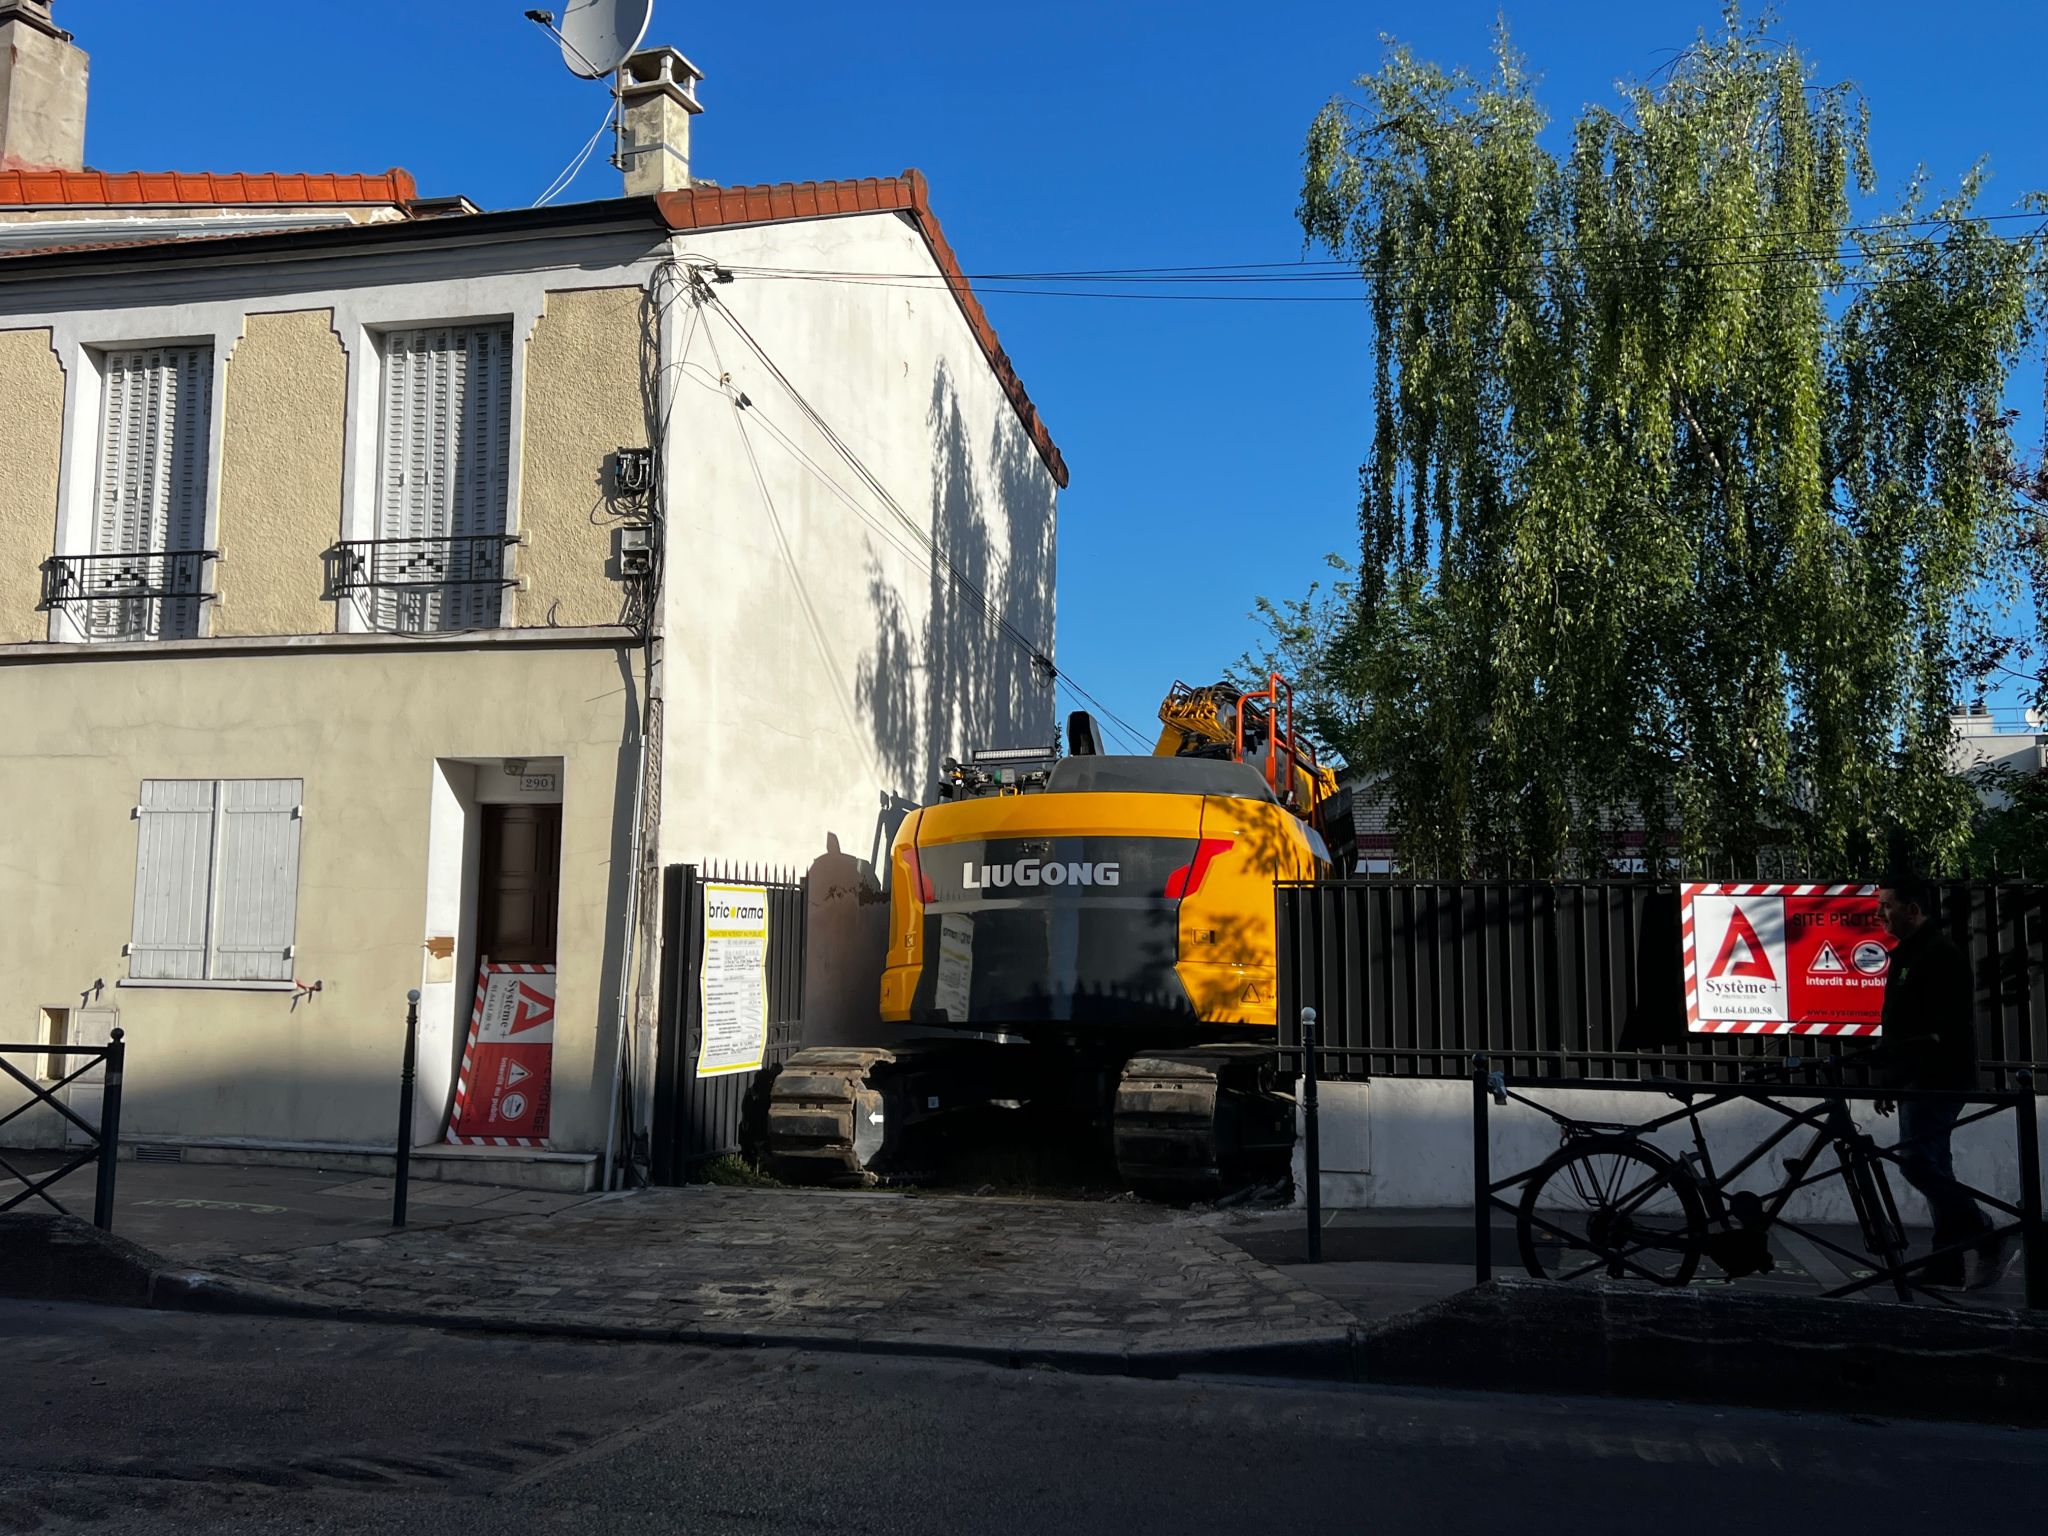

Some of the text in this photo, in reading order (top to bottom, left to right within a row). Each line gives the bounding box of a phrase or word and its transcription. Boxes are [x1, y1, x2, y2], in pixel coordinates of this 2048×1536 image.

[526, 778, 548, 789] 290
[708, 901, 764, 919] bricorama
[1793, 911, 1884, 927] SITE PROTE
[1706, 979, 1767, 996] Système
[1861, 977, 1888, 989] publi
[500, 979, 519, 1028] Système
[1713, 1006, 1773, 1015] 01.64.61.00.58
